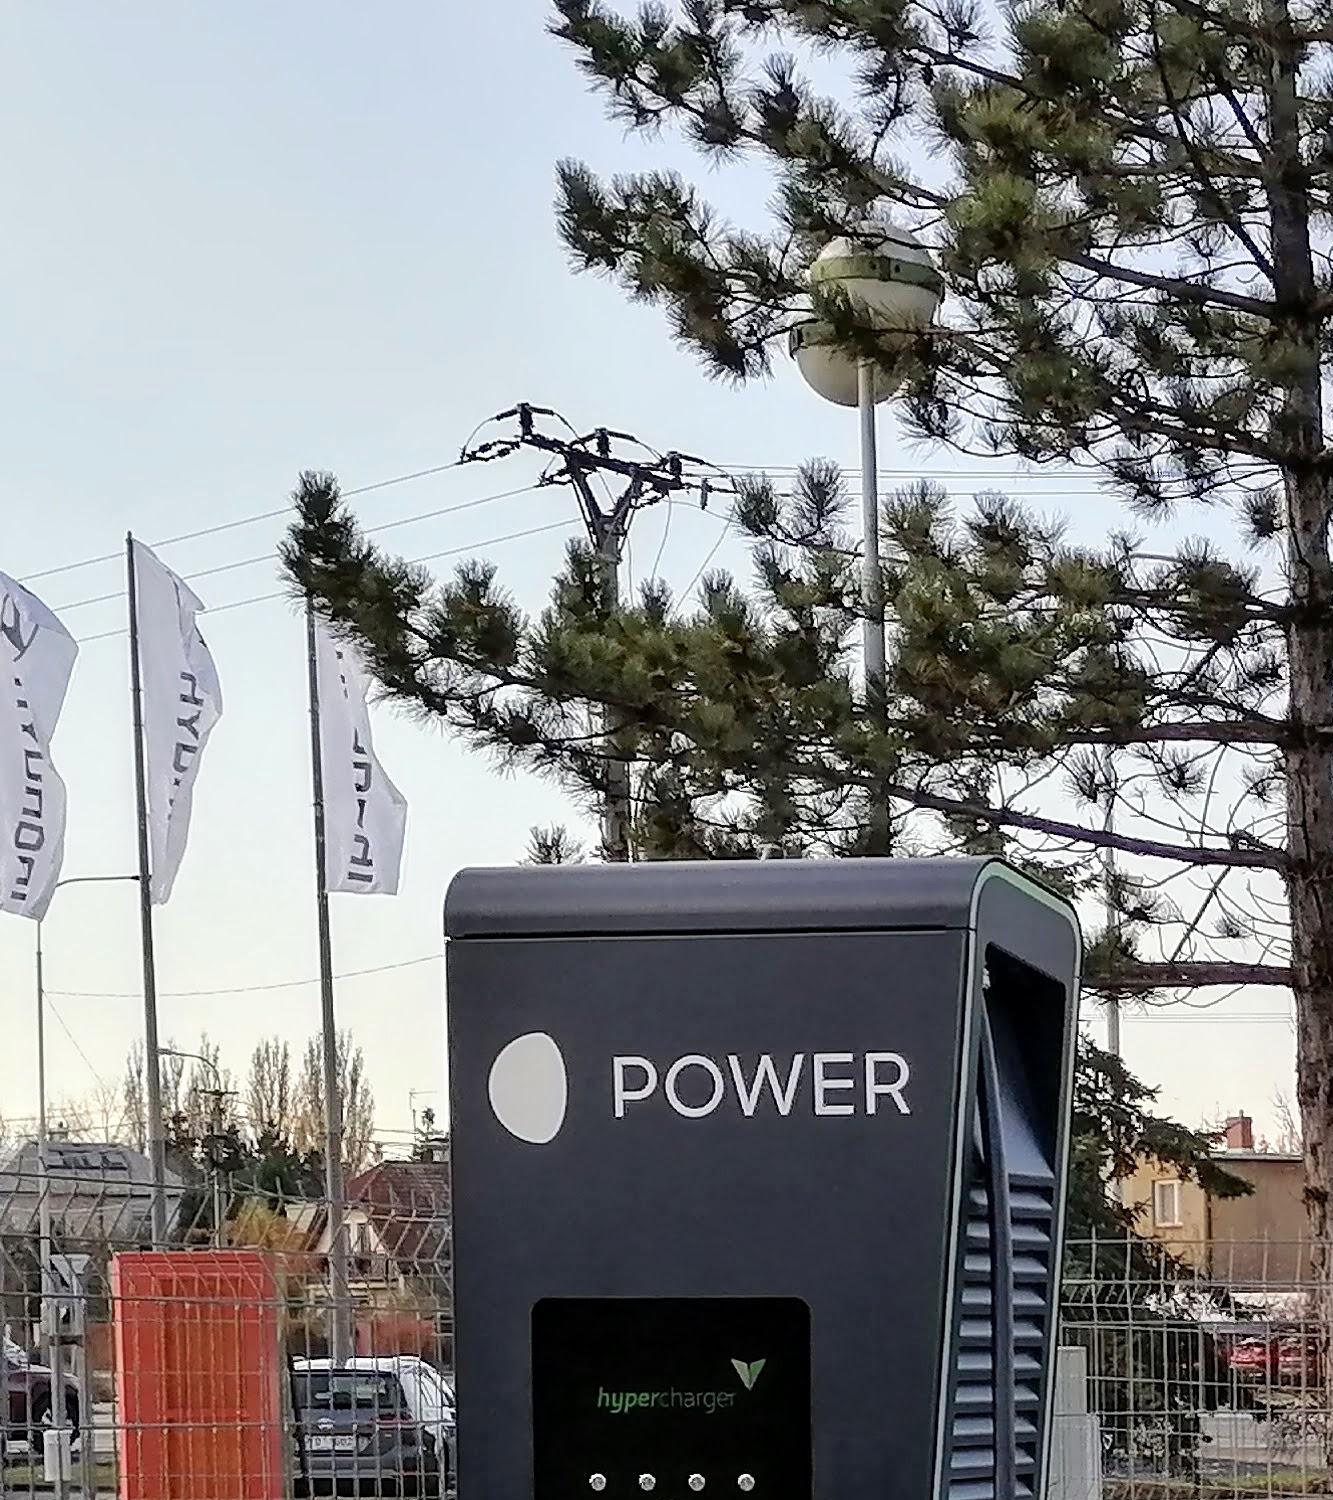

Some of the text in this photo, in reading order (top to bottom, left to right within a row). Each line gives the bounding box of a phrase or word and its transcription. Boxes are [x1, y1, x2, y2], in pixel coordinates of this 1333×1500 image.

[10, 677, 46, 901] YUNDAI
[613, 1051, 912, 1119] POWER
[597, 1386, 736, 1414] hypercharger
